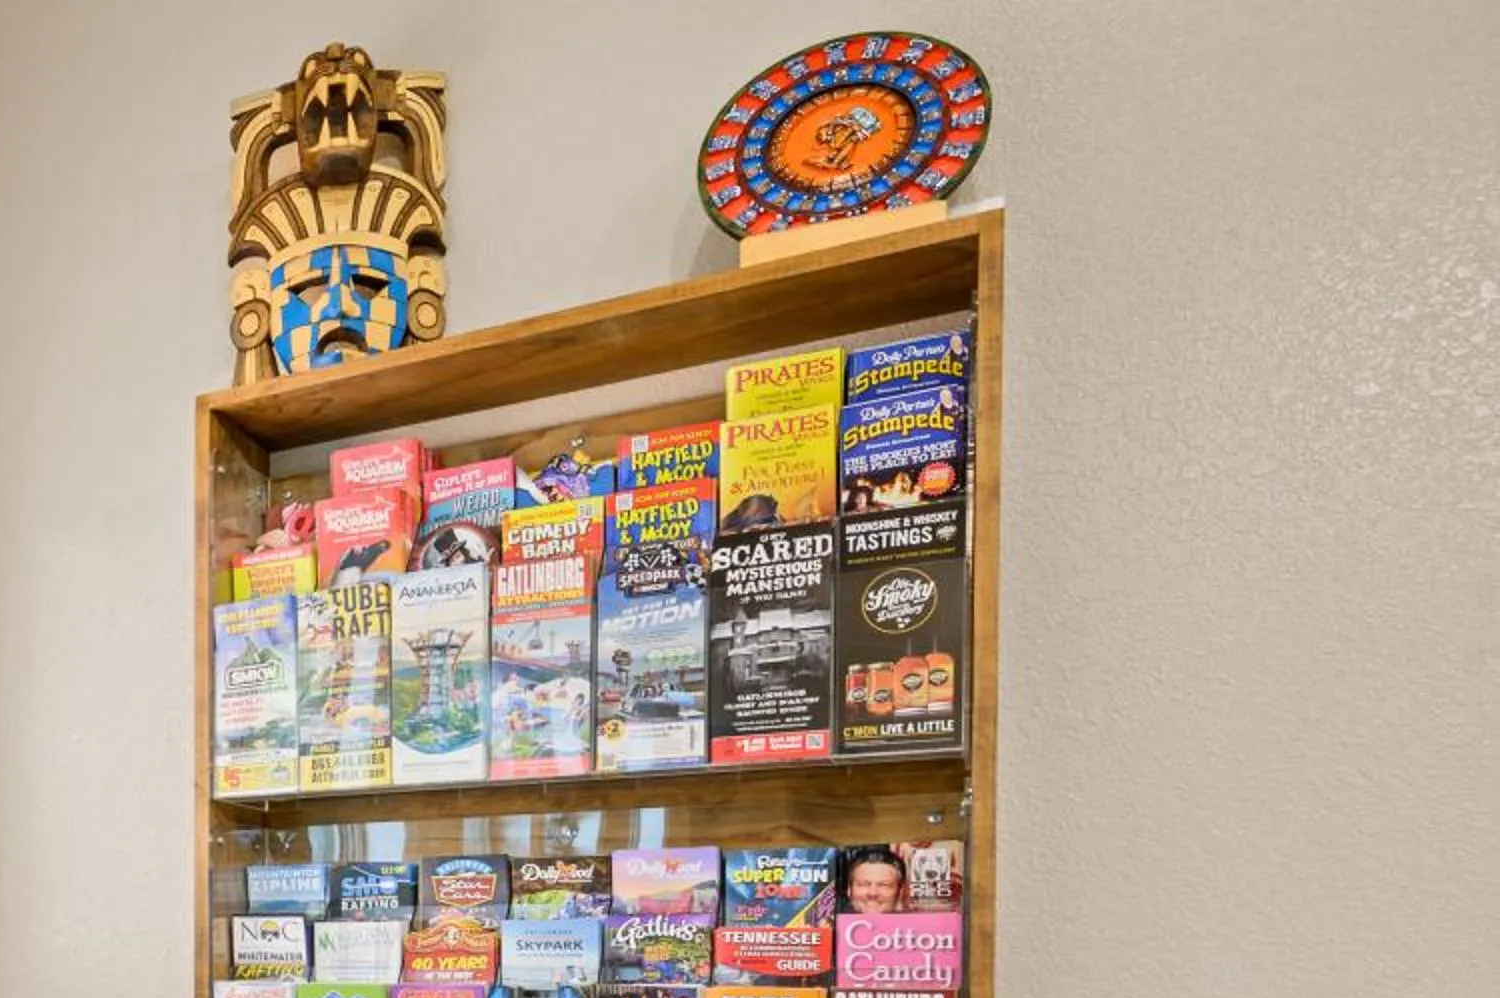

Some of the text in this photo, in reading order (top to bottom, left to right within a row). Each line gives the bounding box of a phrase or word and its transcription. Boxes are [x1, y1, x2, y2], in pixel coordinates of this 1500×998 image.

[735, 356, 835, 393] PIRATES
[853, 349, 965, 395] Stampede
[726, 411, 830, 449] PIRATES
[843, 401, 955, 452] Stampede
[631, 440, 713, 471] HATFIELD
[636, 472, 647, 487] &
[616, 498, 699, 529] HATFIELD
[846, 519, 901, 534] MOONSHINE
[913, 510, 958, 527] WHISKEY
[507, 518, 592, 546] COMEDY
[846, 527, 932, 553] TASTINGS
[522, 539, 576, 560] BARN
[711, 533, 833, 572] SCARED
[726, 559, 823, 583] MYSTERIOUS
[726, 573, 821, 597] MANSION
[328, 583, 390, 614] TUBE
[866, 579, 936, 612] Smoky
[332, 610, 390, 641] RAFT
[601, 599, 703, 634] MOTION
[880, 723, 902, 736] LIVE
[907, 722, 916, 734] A
[917, 720, 955, 734] LITTLE
[732, 867, 828, 884] SUPER FUN
[341, 899, 400, 912] RAFTING
[515, 938, 584, 952] SKYPARK
[611, 915, 699, 948] Gatlin's
[723, 930, 822, 945] TENNESSEE
[845, 919, 954, 950] Cotton
[438, 955, 489, 970] YEARS
[775, 959, 822, 971] GUIDE
[845, 951, 952, 988] Candy
